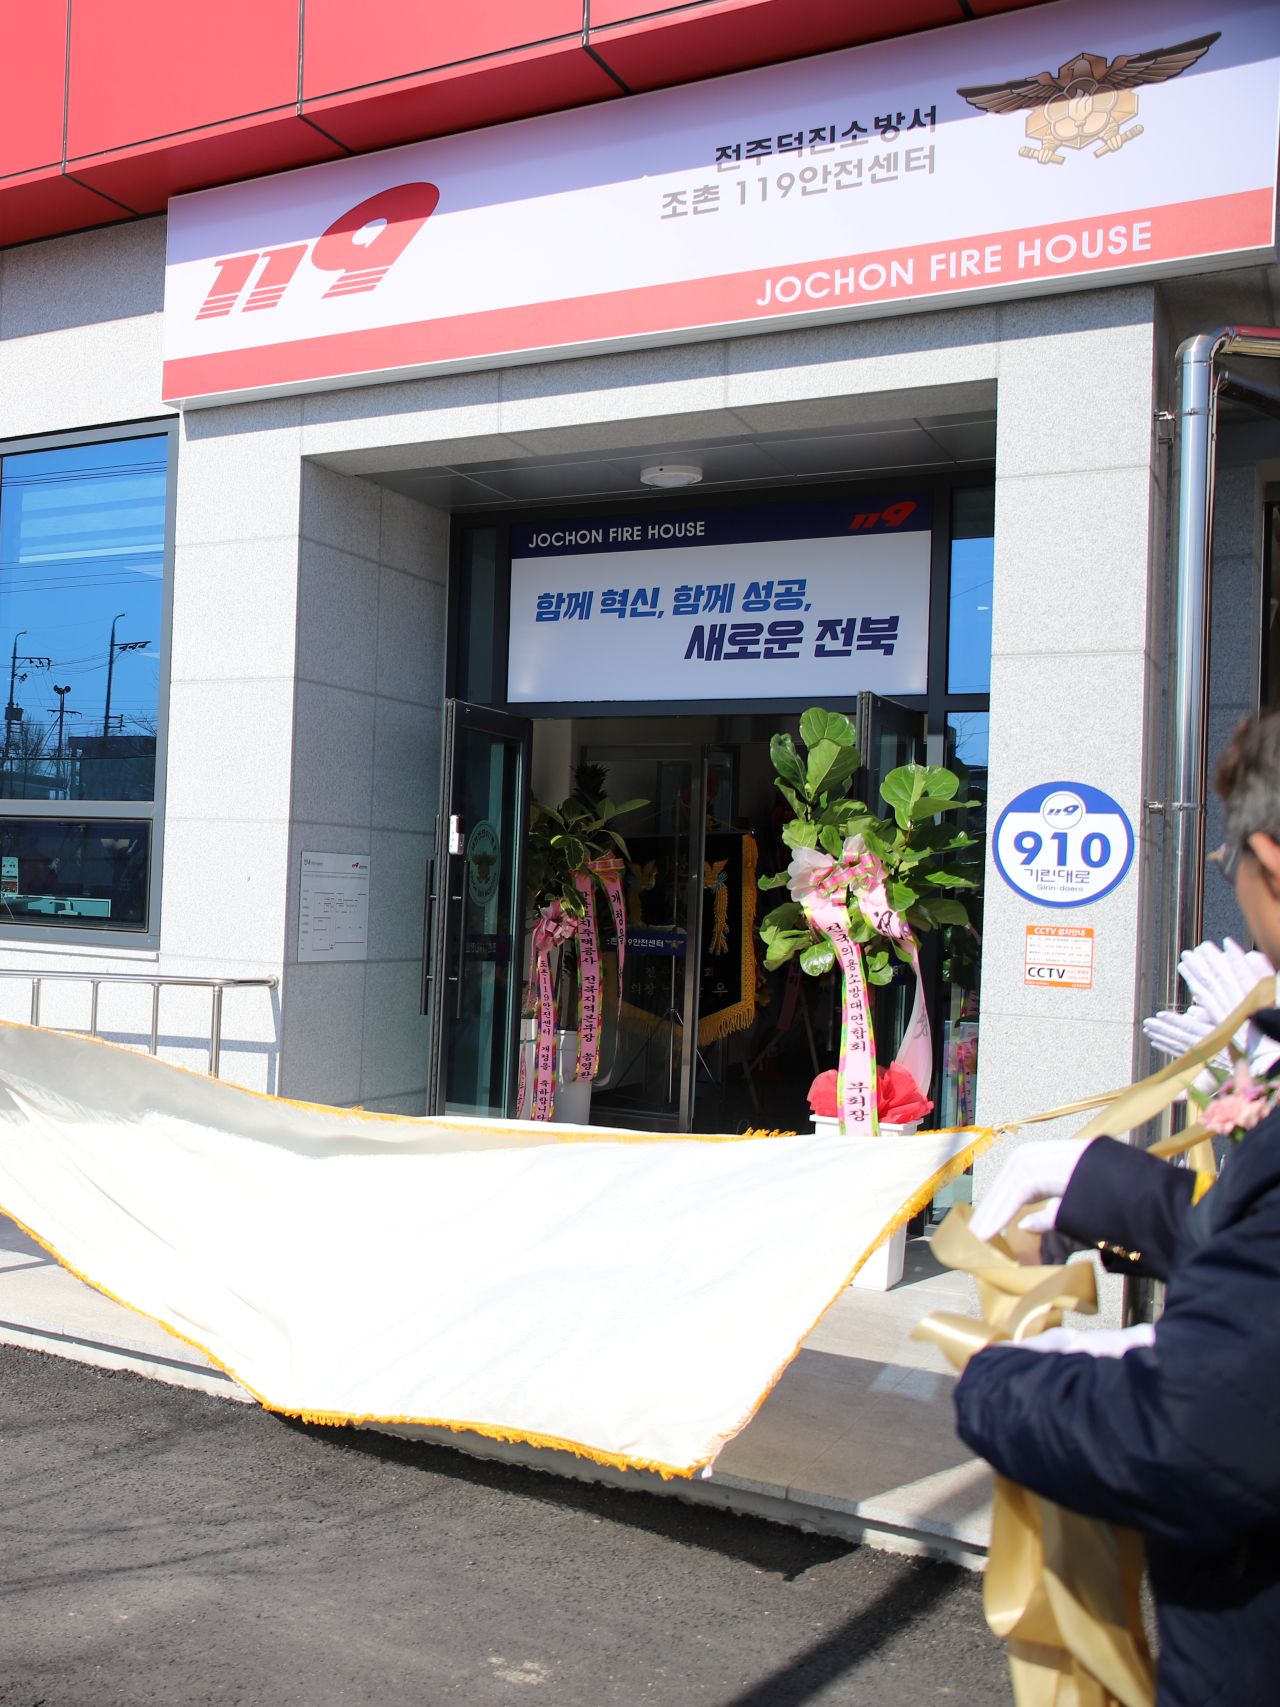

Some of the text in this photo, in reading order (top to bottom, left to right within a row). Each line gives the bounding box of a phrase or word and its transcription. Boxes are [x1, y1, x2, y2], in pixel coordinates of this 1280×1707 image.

[715, 105, 937, 173] 전주덕진소방서
[660, 145, 936, 220] 조촌 119안전센터
[195, 181, 440, 321] 119
[756, 220, 1152, 307] JOCHON FIRE HOUSE
[847, 500, 917, 530] 119
[528, 521, 705, 548] JOCHON FIRE HOUSE
[535, 578, 812, 622] 함께 혁신, 함께 성공,
[683, 615, 900, 662] 새로운 전북
[1047, 805, 1080, 815] 119
[1013, 831, 1111, 868] 910
[1024, 869, 1090, 884] 기린대로
[1034, 927, 1057, 935] CCTV
[1028, 967, 1066, 979] CCTV
[846, 1082, 870, 1122] 부회장
